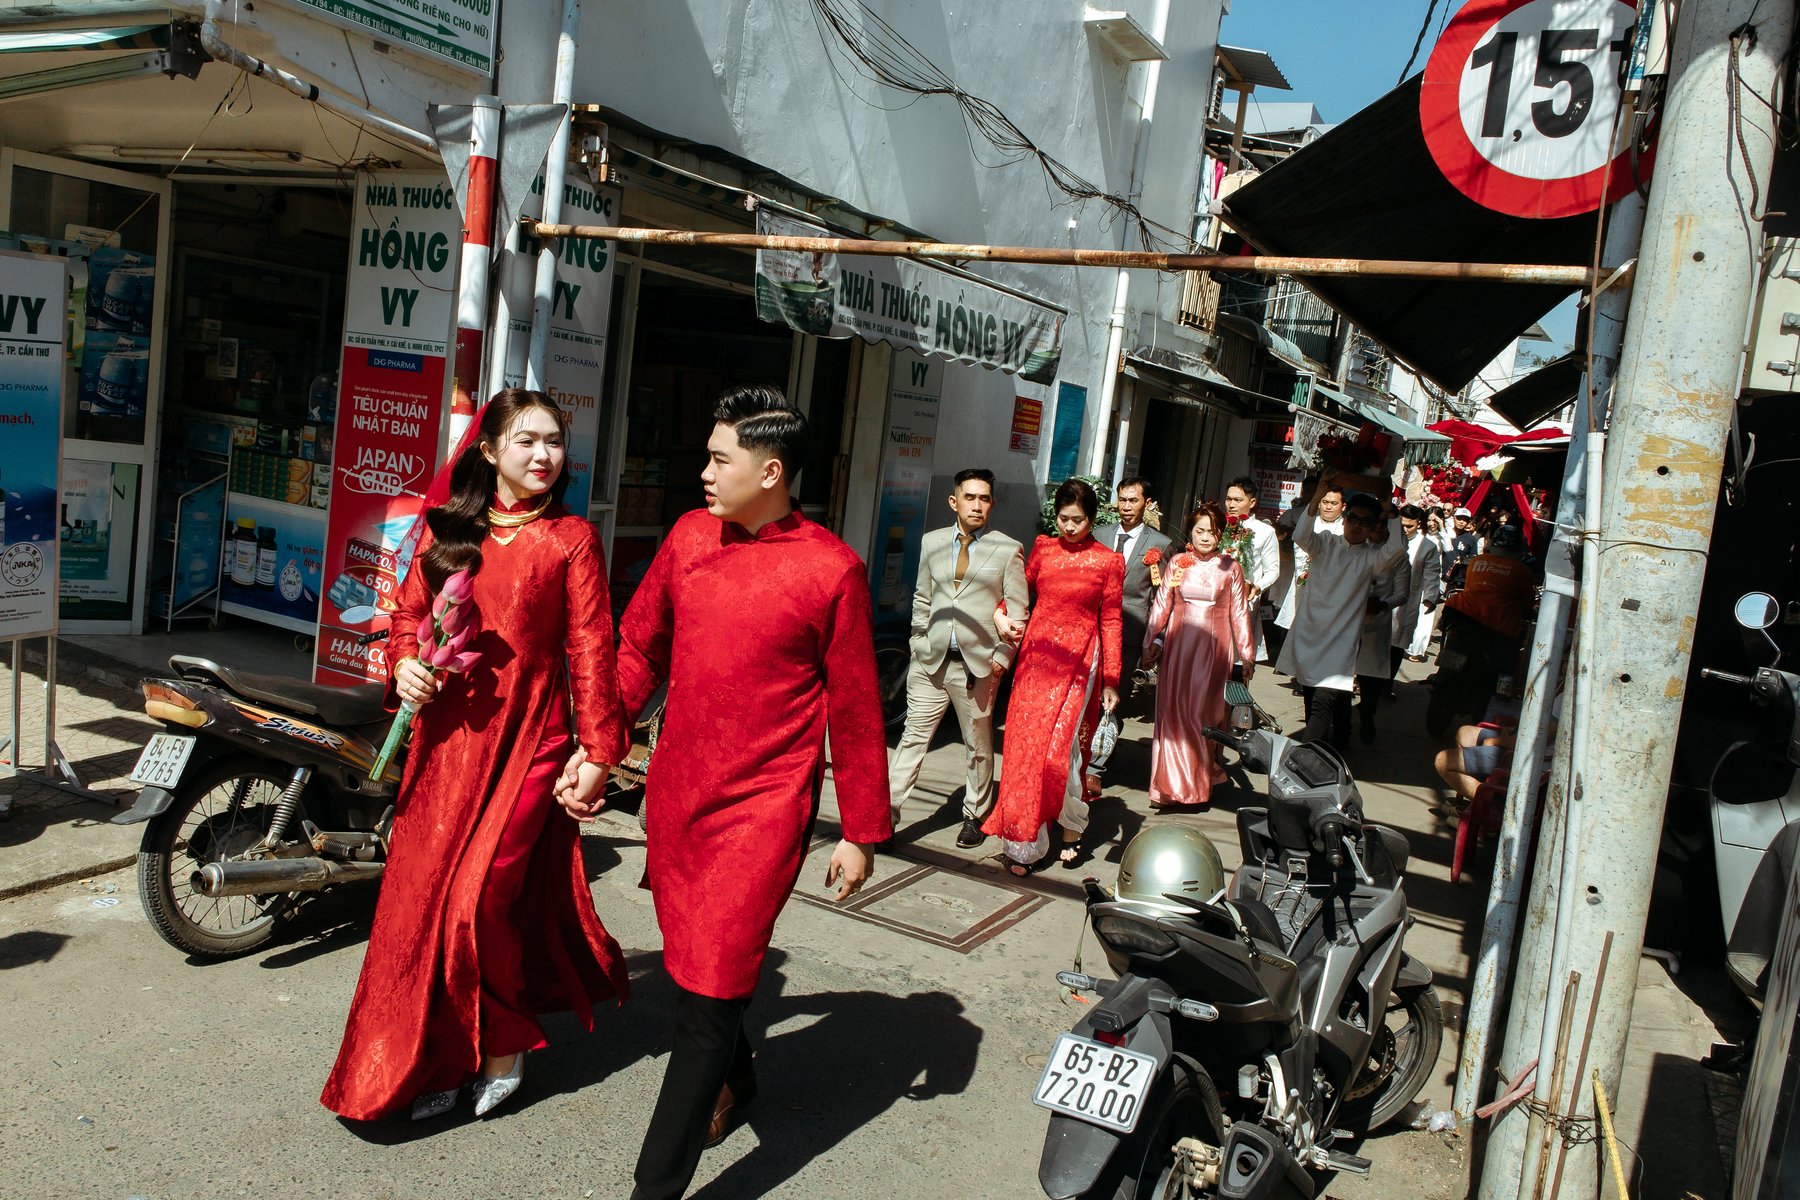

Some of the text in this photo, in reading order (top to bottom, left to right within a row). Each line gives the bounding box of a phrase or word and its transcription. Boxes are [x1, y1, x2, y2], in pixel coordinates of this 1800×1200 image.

[333, 4, 345, 16] ĐC:
[346, 7, 361, 23] HẺM
[362, 15, 371, 26] 65
[422, 3, 451, 24] RIÊNG
[453, 15, 471, 31] CHO
[473, 23, 489, 40] NỮ)
[366, 181, 453, 210] NHÀ THUỐC
[564, 184, 613, 218] THUỐC
[359, 216, 449, 273] HỒNG
[380, 286, 420, 328] VY
[839, 269, 875, 314] NHÀ
[881, 281, 931, 328] THUỐC
[934, 288, 997, 361] HỒNG
[1002, 318, 1026, 368] VY
[6, 346, 17, 355] TP.
[35, 347, 50, 357] THƠ
[373, 357, 416, 370] DHG PHARMA
[553, 354, 600, 369] DHG PHARMA
[911, 360, 929, 388] VY
[352, 394, 428, 420] TIÊU CHUẨN
[352, 414, 420, 438] NHẬT BẢN
[890, 431, 933, 447] NattoEnzym
[352, 446, 414, 475] JAPAN
[359, 469, 402, 496] GMP
[348, 544, 393, 571] HAPACOL
[365, 573, 391, 593] 650
[330, 638, 386, 665] HAPACO
[137, 759, 177, 783] 9765
[1064, 1043, 1139, 1088] 65-B2
[1041, 1071, 1137, 1123] 720.00
